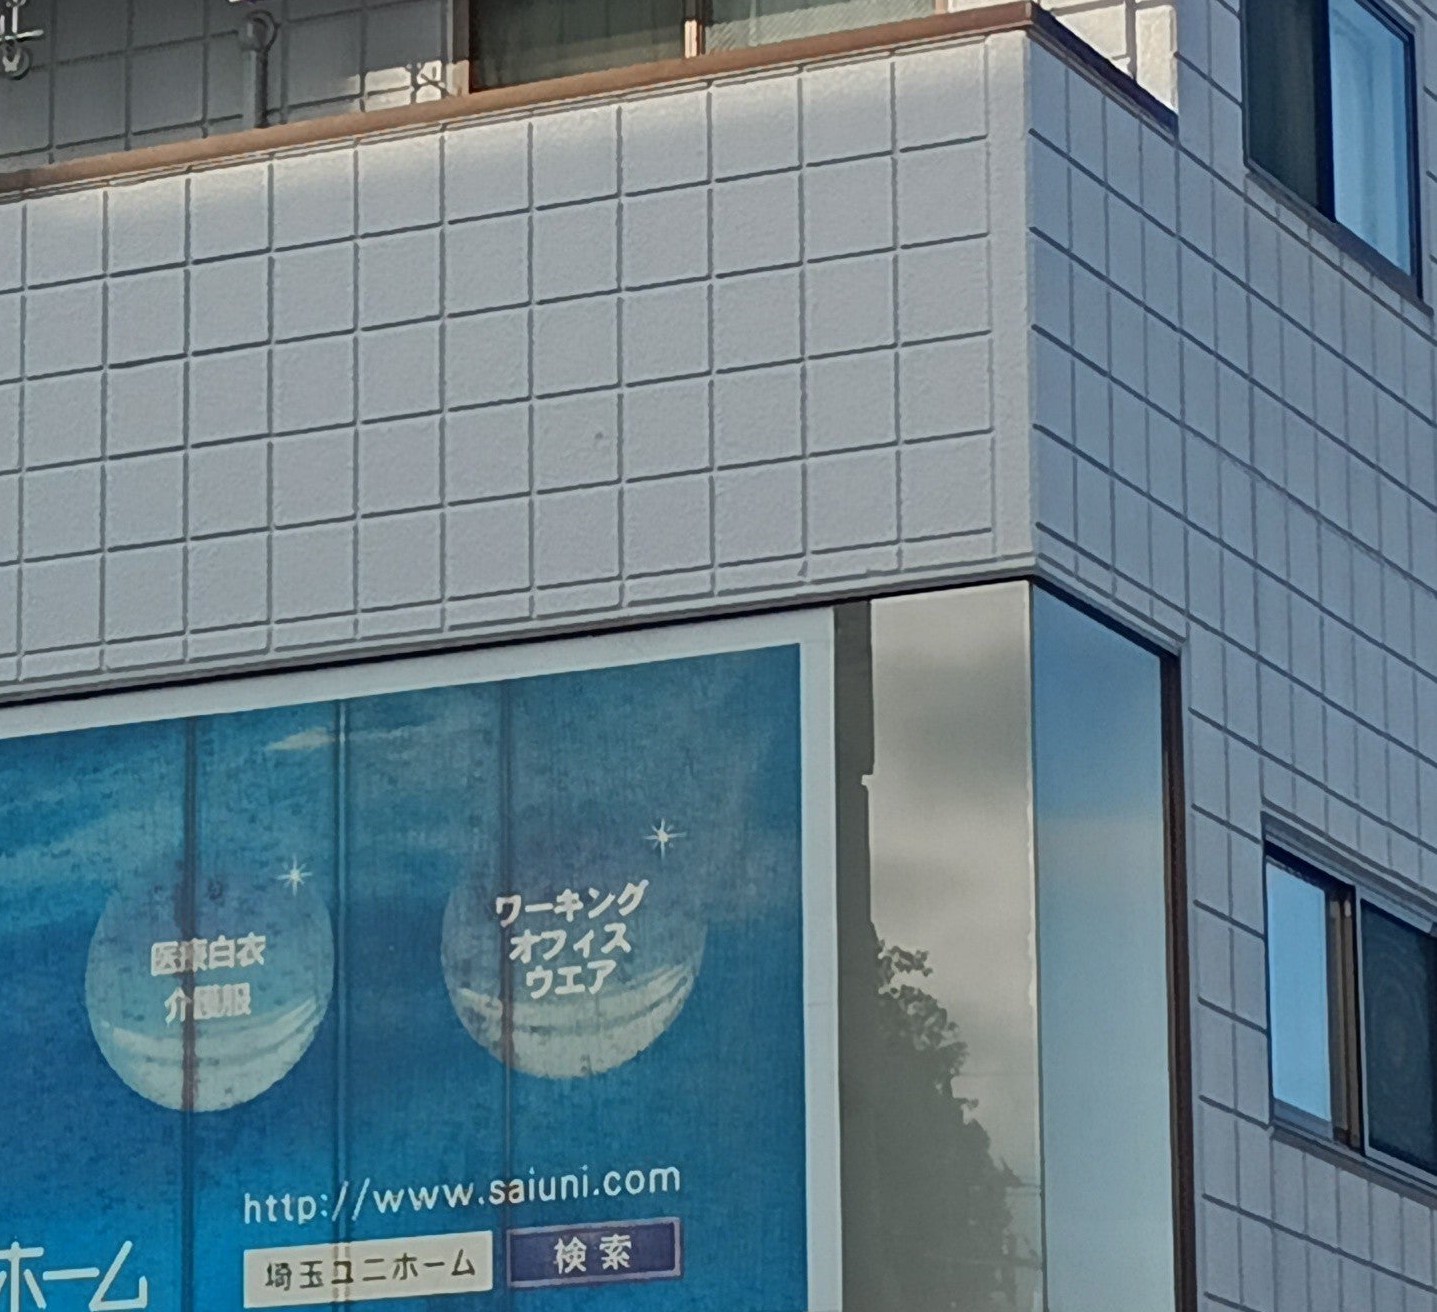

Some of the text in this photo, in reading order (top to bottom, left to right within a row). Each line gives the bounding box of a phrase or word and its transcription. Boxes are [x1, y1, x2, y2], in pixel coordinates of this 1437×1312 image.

[495, 879, 650, 928] ワーキング
[150, 932, 267, 977] 医療白衣
[509, 922, 632, 964] オフィス
[526, 959, 617, 999] ウエア
[243, 1165, 682, 1225] http://www.saiuni.com
[265, 1248, 476, 1291] 埼玉ユニホーム
[553, 1233, 633, 1275] 検索
